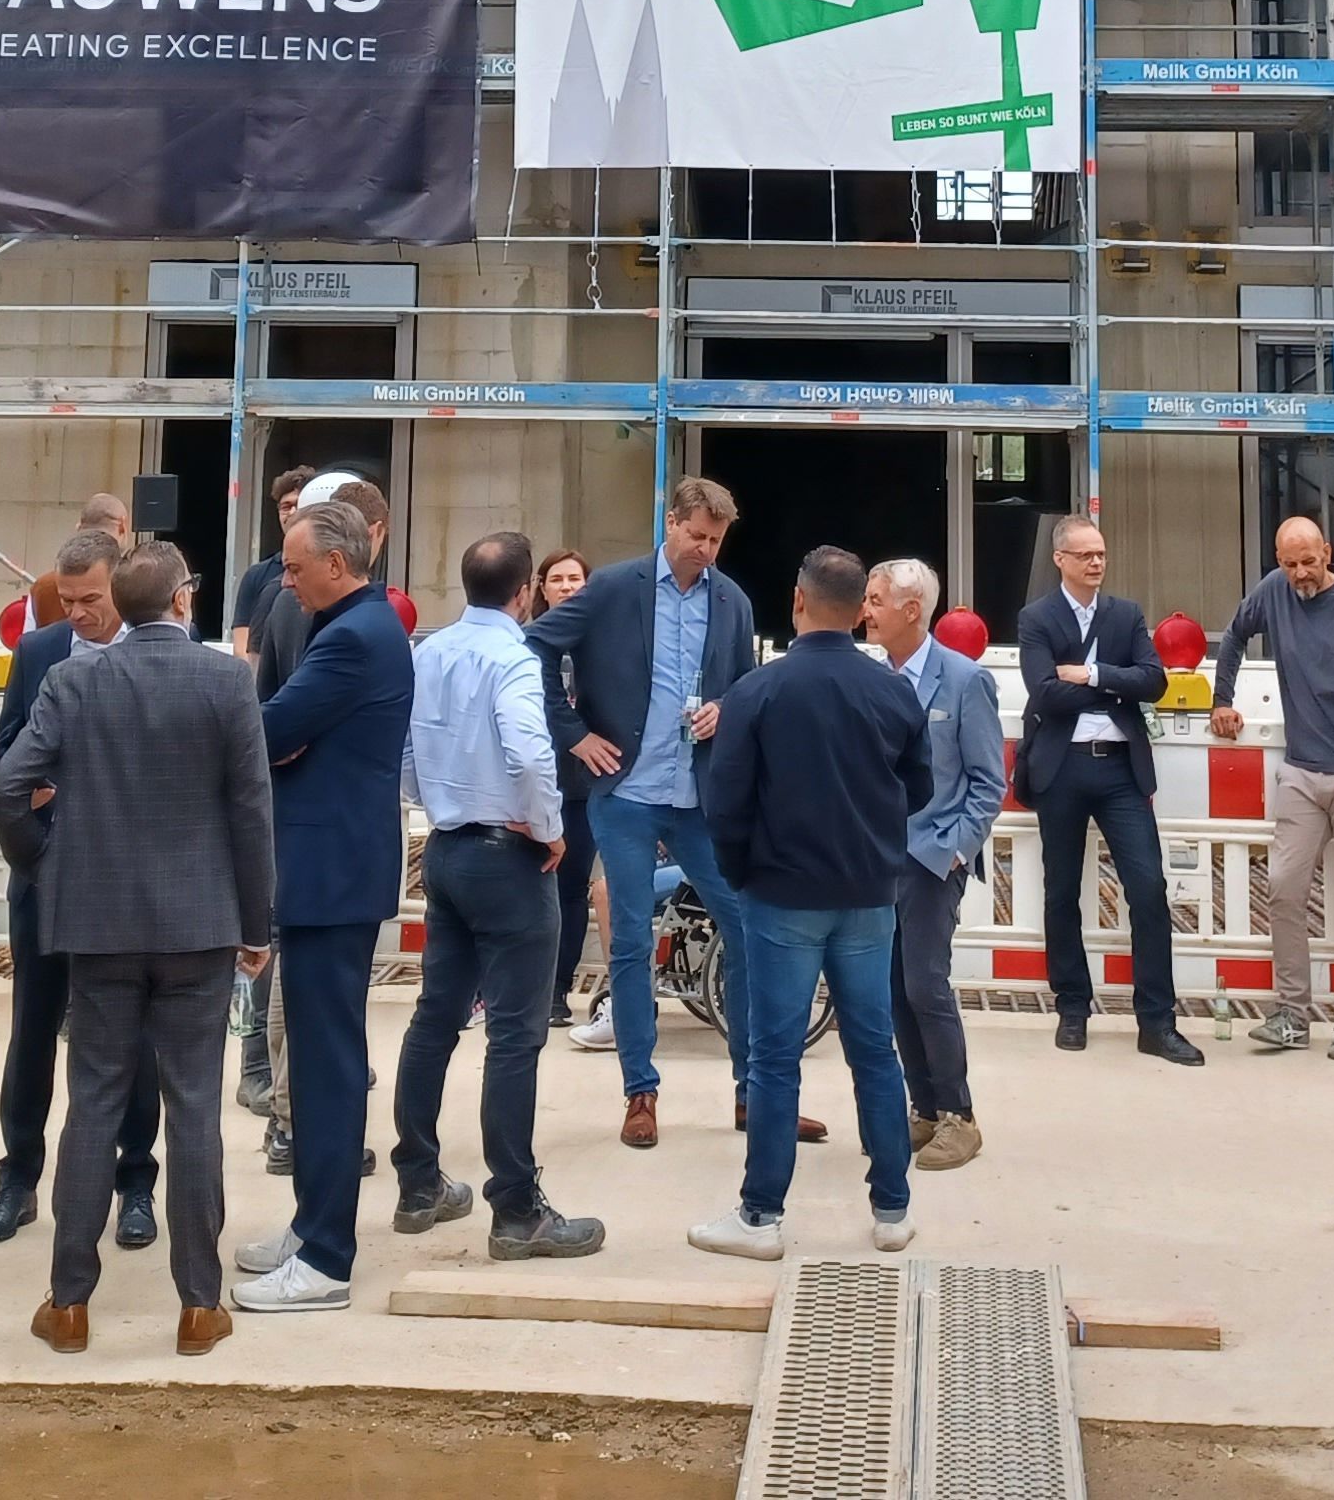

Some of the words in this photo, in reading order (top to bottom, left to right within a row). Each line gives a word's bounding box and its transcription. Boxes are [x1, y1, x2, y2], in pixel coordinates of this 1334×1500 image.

[143, 33, 377, 62] EXCELLENCE
[1143, 63, 1189, 79] Melik
[1195, 63, 1250, 79] GmbH
[1256, 63, 1298, 79] Köln
[900, 119, 936, 133] LEBEN
[938, 116, 954, 128] SO
[957, 112, 988, 126] BUNT
[990, 109, 1014, 123] WIE
[1015, 105, 1047, 120] KÖLN
[304, 272, 351, 289] PFEIL
[854, 289, 906, 305] KLAUS
[912, 290, 958, 306] PFEIL
[373, 385, 419, 401] Melik
[424, 385, 478, 401] GmbH
[484, 385, 525, 402] Köln
[799, 387, 841, 403] Köln
[847, 387, 902, 403] GmbH
[908, 388, 954, 404] Melik
[1147, 397, 1195, 413] Melik
[1201, 398, 1258, 414] GmbH
[1264, 398, 1307, 415] Köln
